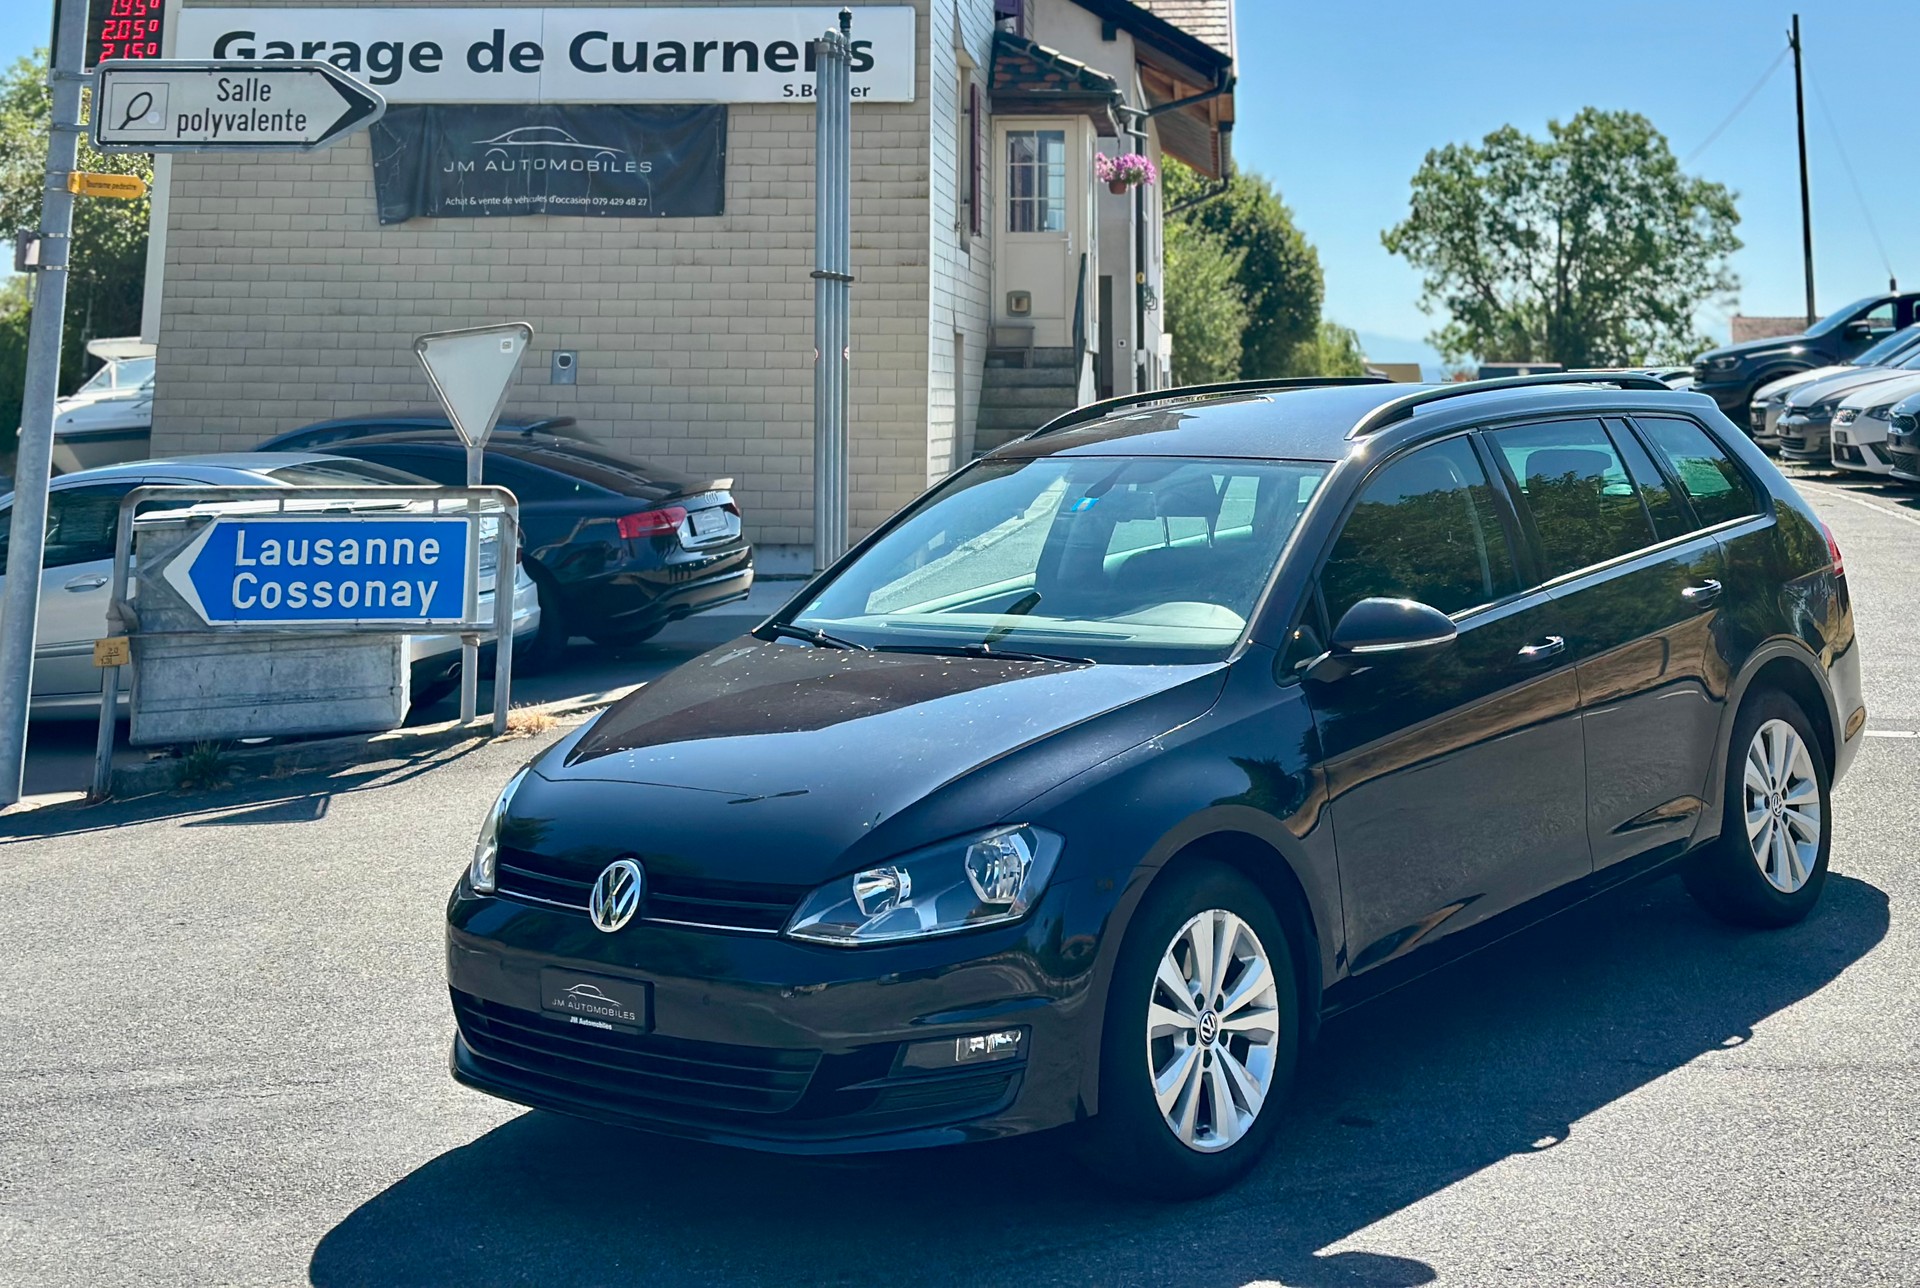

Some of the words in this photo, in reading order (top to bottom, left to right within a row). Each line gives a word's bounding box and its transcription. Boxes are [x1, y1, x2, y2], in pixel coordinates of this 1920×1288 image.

[213, 30, 443, 85] Garage
[466, 29, 544, 73] de
[217, 77, 272, 102] Salle
[177, 107, 307, 138] polyvalente
[443, 161, 475, 173] JM
[485, 158, 652, 173] AUTOMOBILES
[445, 197, 468, 206] Achat
[469, 196, 477, 206] &
[478, 196, 501, 205] vente
[502, 195, 513, 205] de
[592, 197, 608, 206] 079
[609, 197, 624, 206] 429
[625, 197, 637, 206] 48
[637, 197, 648, 206] 27
[235, 529, 441, 567] Lausanne
[231, 571, 439, 617] Cossonay
[552, 998, 565, 1007] JM
[567, 1001, 636, 1021] AUTOMOBILES
